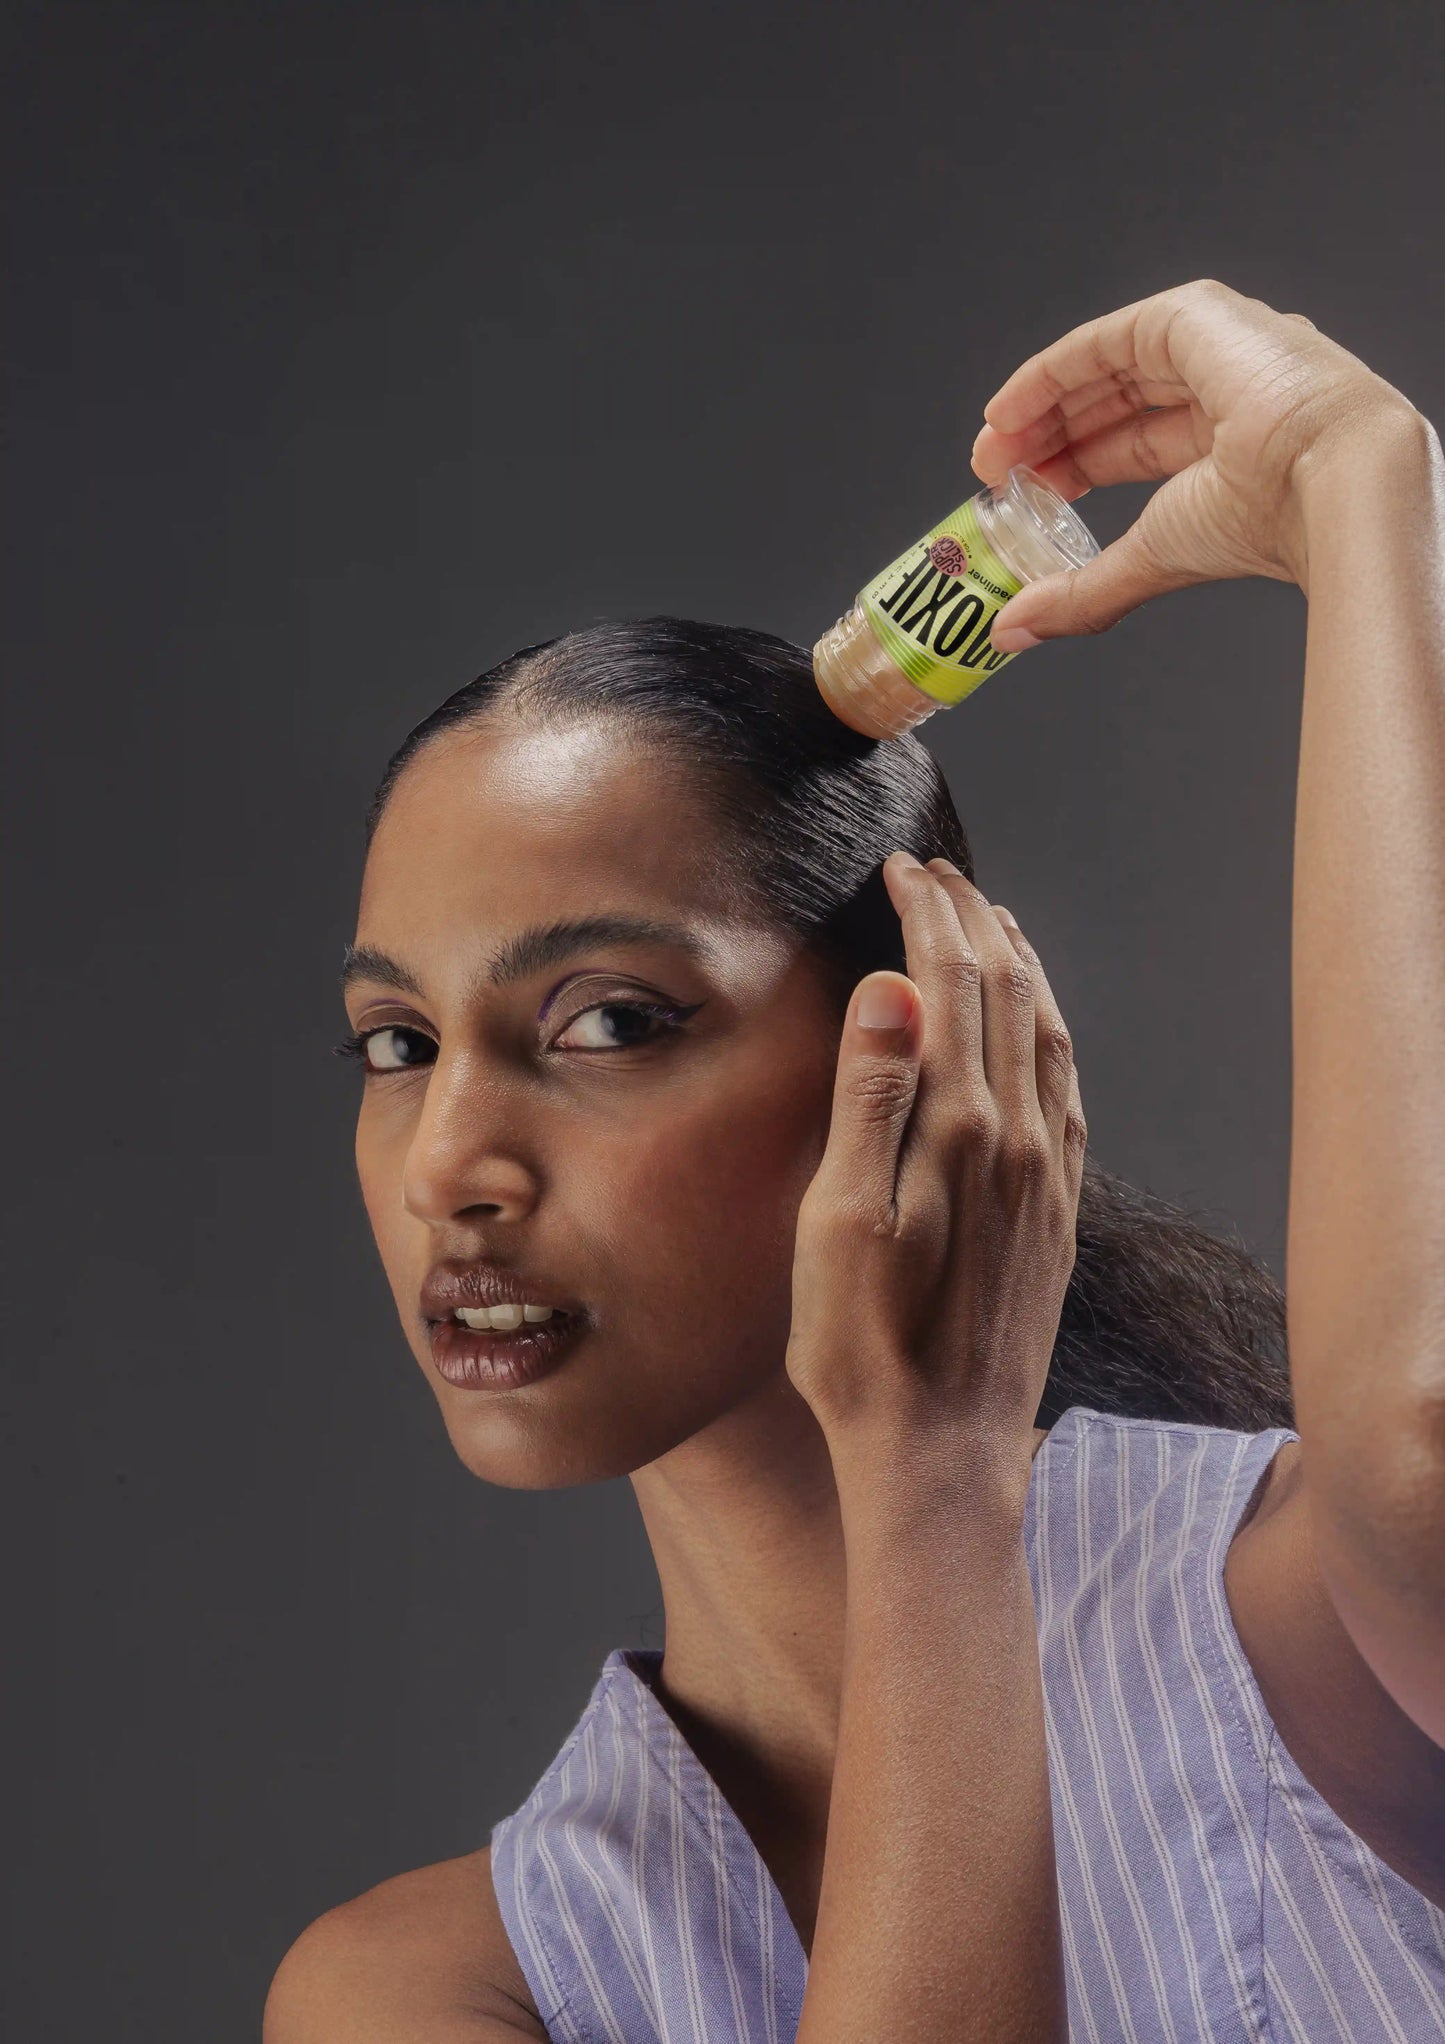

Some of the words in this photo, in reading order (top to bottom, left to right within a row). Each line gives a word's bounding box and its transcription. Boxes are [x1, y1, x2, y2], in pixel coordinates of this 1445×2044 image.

[930, 543, 962, 574] SUPER
[938, 537, 965, 563] SLICK
[967, 568, 1014, 601] eadliner
